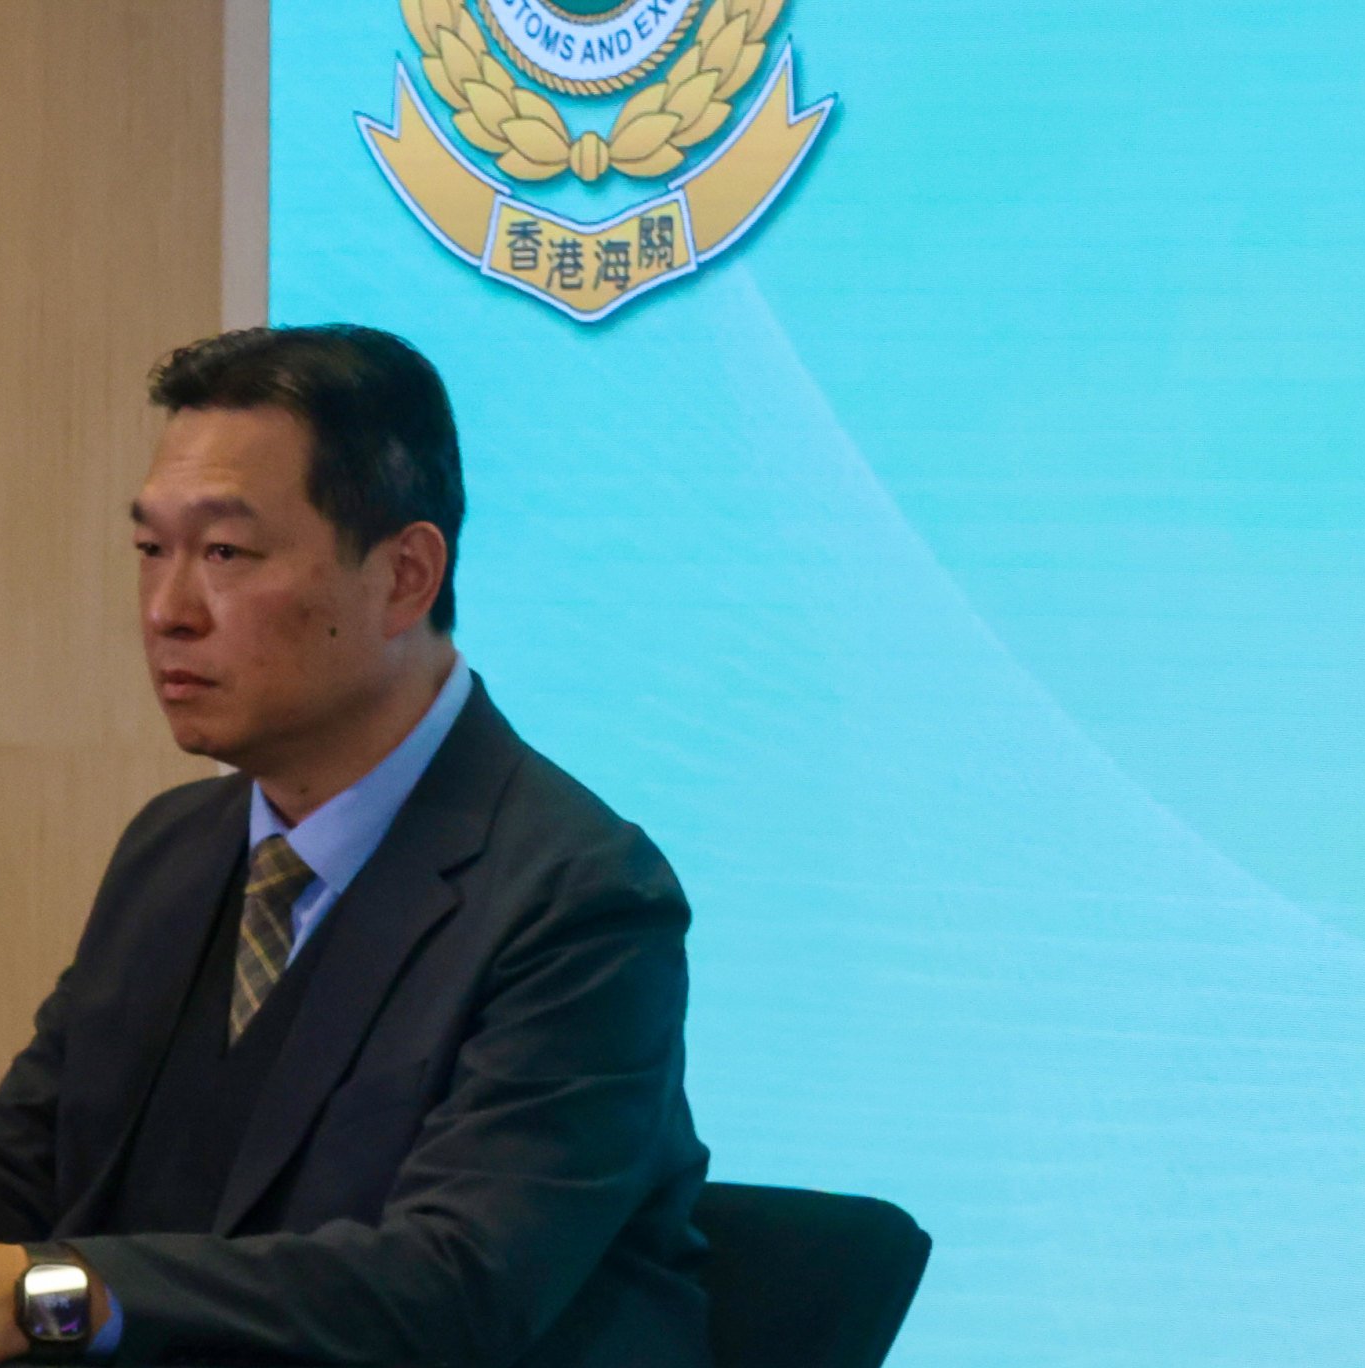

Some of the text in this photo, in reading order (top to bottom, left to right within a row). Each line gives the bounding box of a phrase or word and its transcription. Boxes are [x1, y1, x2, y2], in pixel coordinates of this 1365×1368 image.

[503, 0, 575, 61] TOMS
[579, 28, 633, 64] AND
[505, 215, 676, 291] 香港海關
